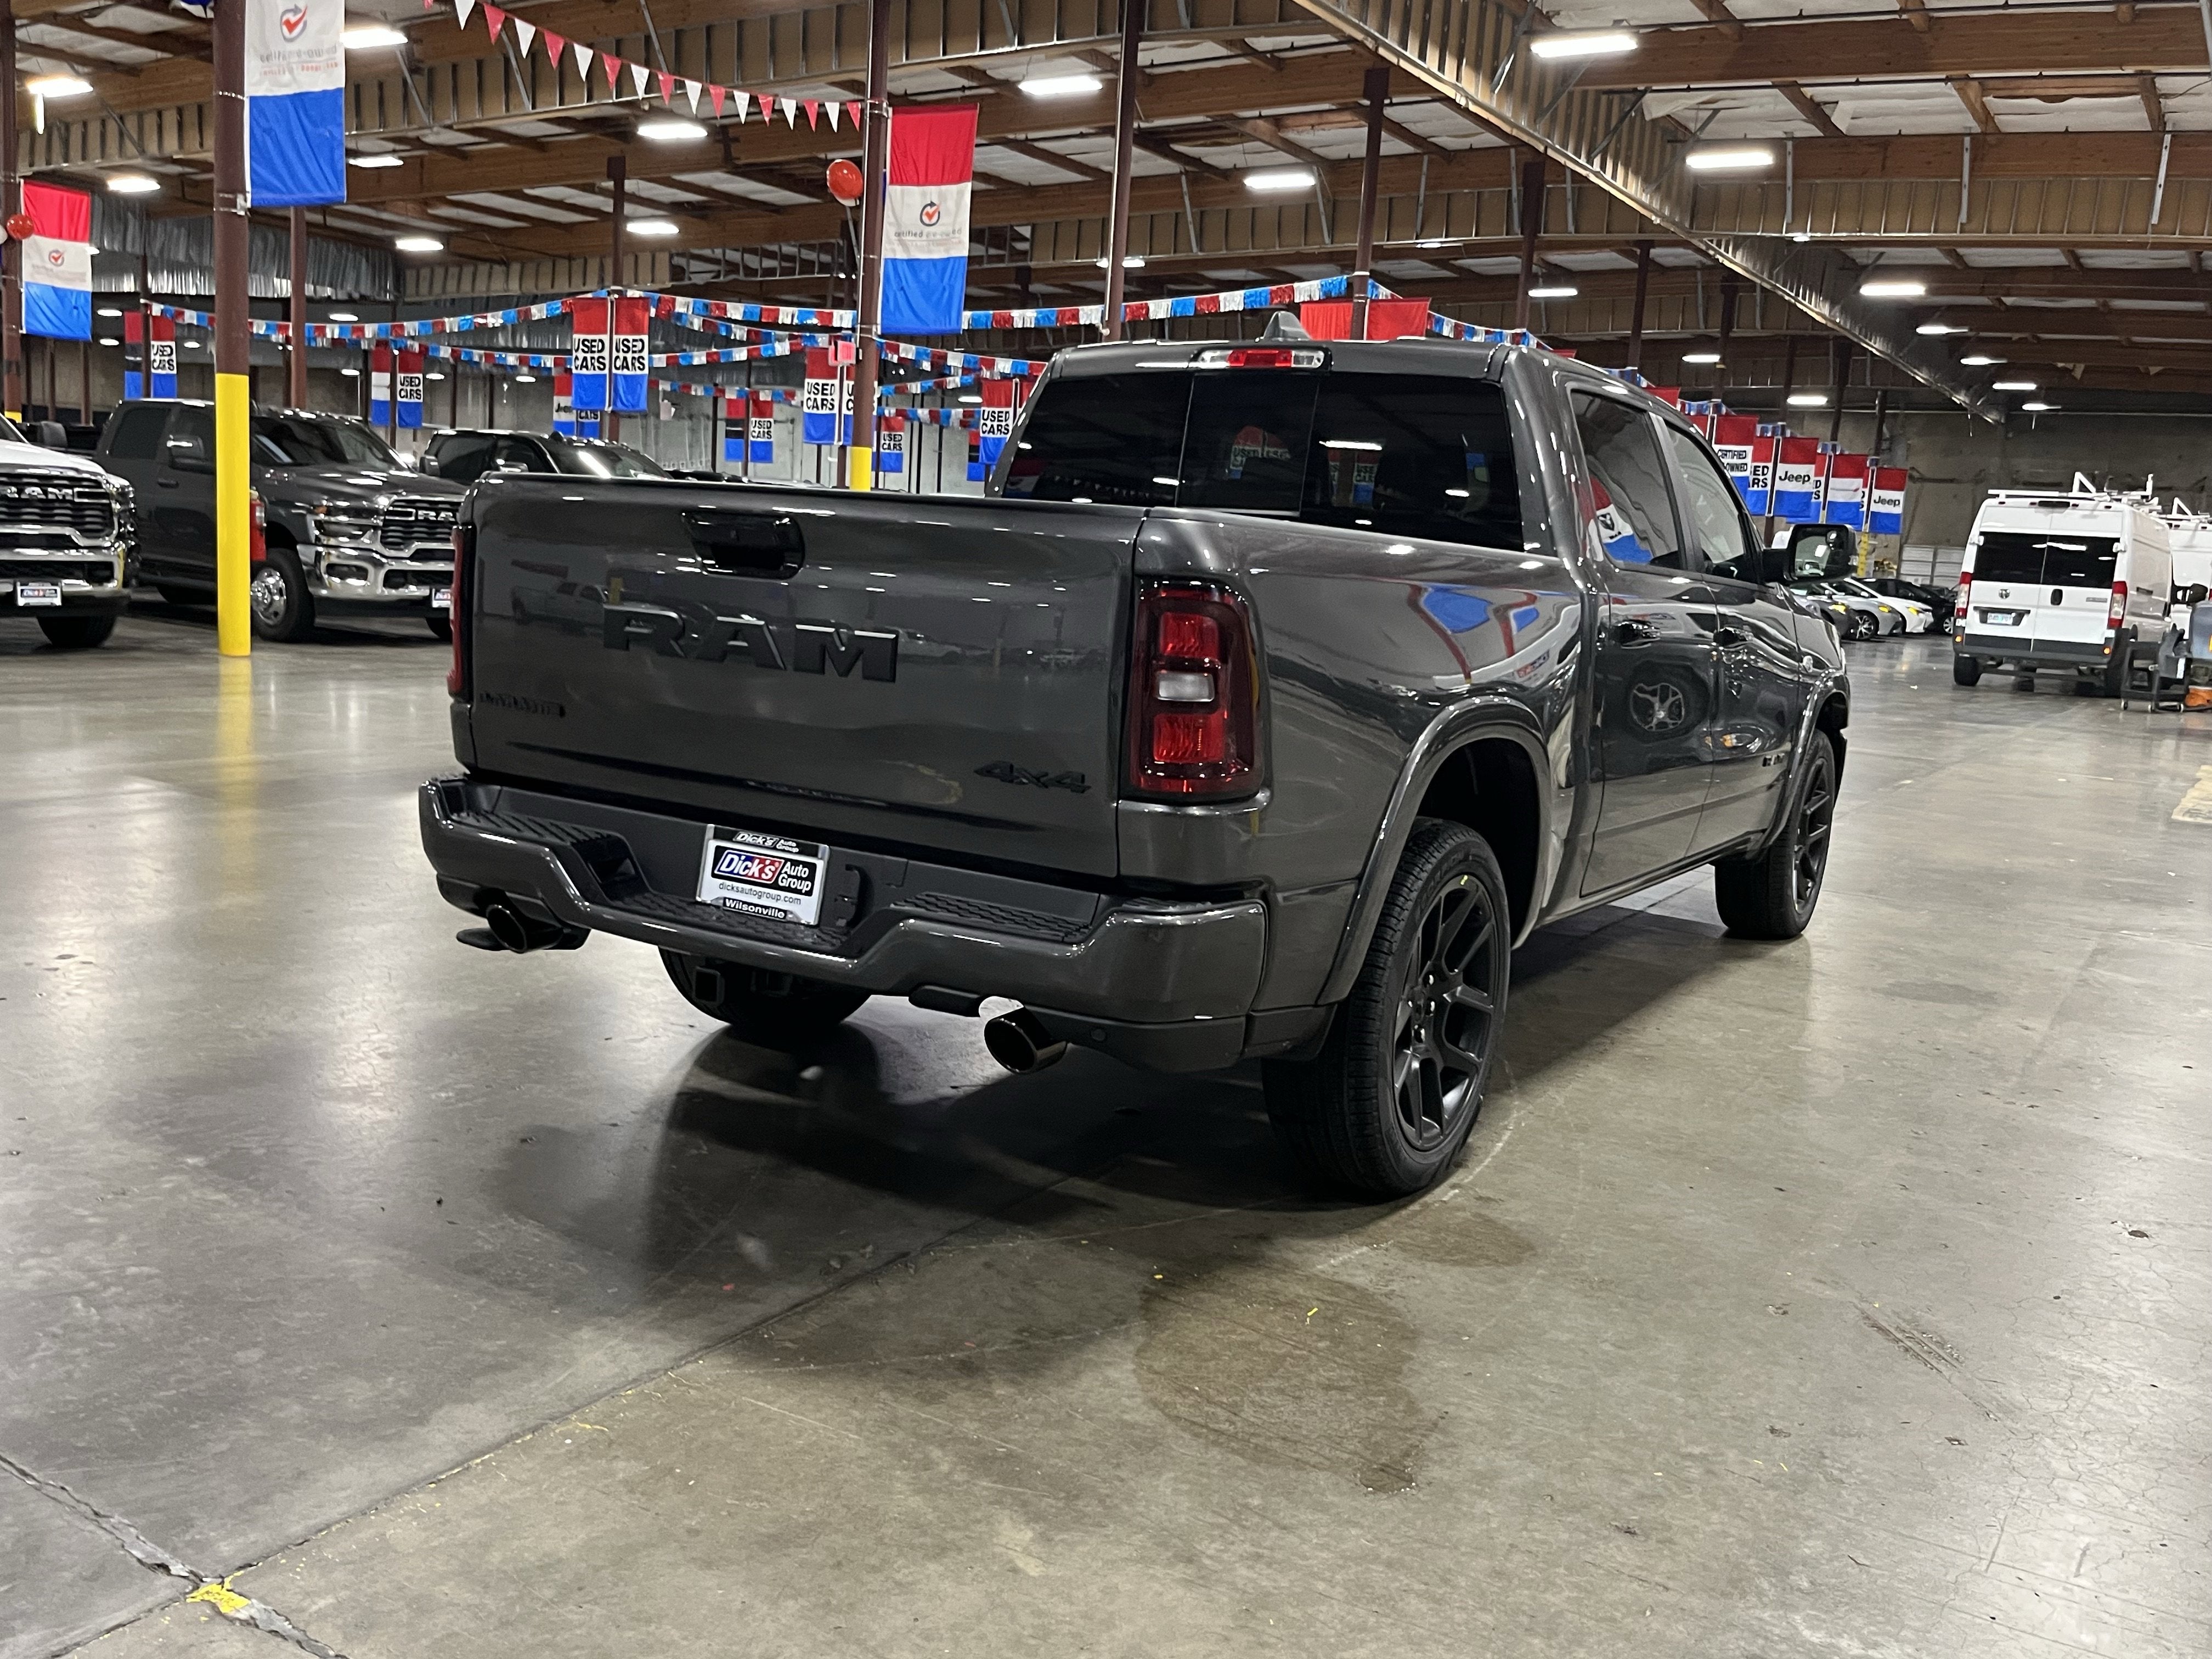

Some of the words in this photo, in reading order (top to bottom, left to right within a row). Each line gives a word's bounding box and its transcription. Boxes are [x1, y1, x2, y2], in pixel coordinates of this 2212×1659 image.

[574, 338, 605, 354] USED
[615, 338, 645, 354] USED
[574, 355, 606, 371] CARS
[614, 355, 646, 371] CARS
[399, 375, 421, 387] USED
[807, 382, 835, 396] USED
[806, 397, 835, 411] CARS
[982, 410, 1010, 422] USED
[751, 420, 772, 430] USED
[981, 422, 1010, 435] CARS
[751, 431, 772, 439] CARS
[883, 433, 902, 442] USED
[882, 443, 902, 452] CARS
[1779, 471, 1811, 485] Jeep
[1874, 495, 1900, 507] Jeep
[417, 510, 456, 522] RA
[603, 604, 899, 684] RAM
[736, 832, 775, 847] Dick's
[719, 853, 776, 879] Dick's
[782, 861, 809, 878] Auto
[778, 874, 812, 893] Group
[719, 882, 802, 905] dicksautogroup.com
[725, 898, 786, 919] Wilsonville
